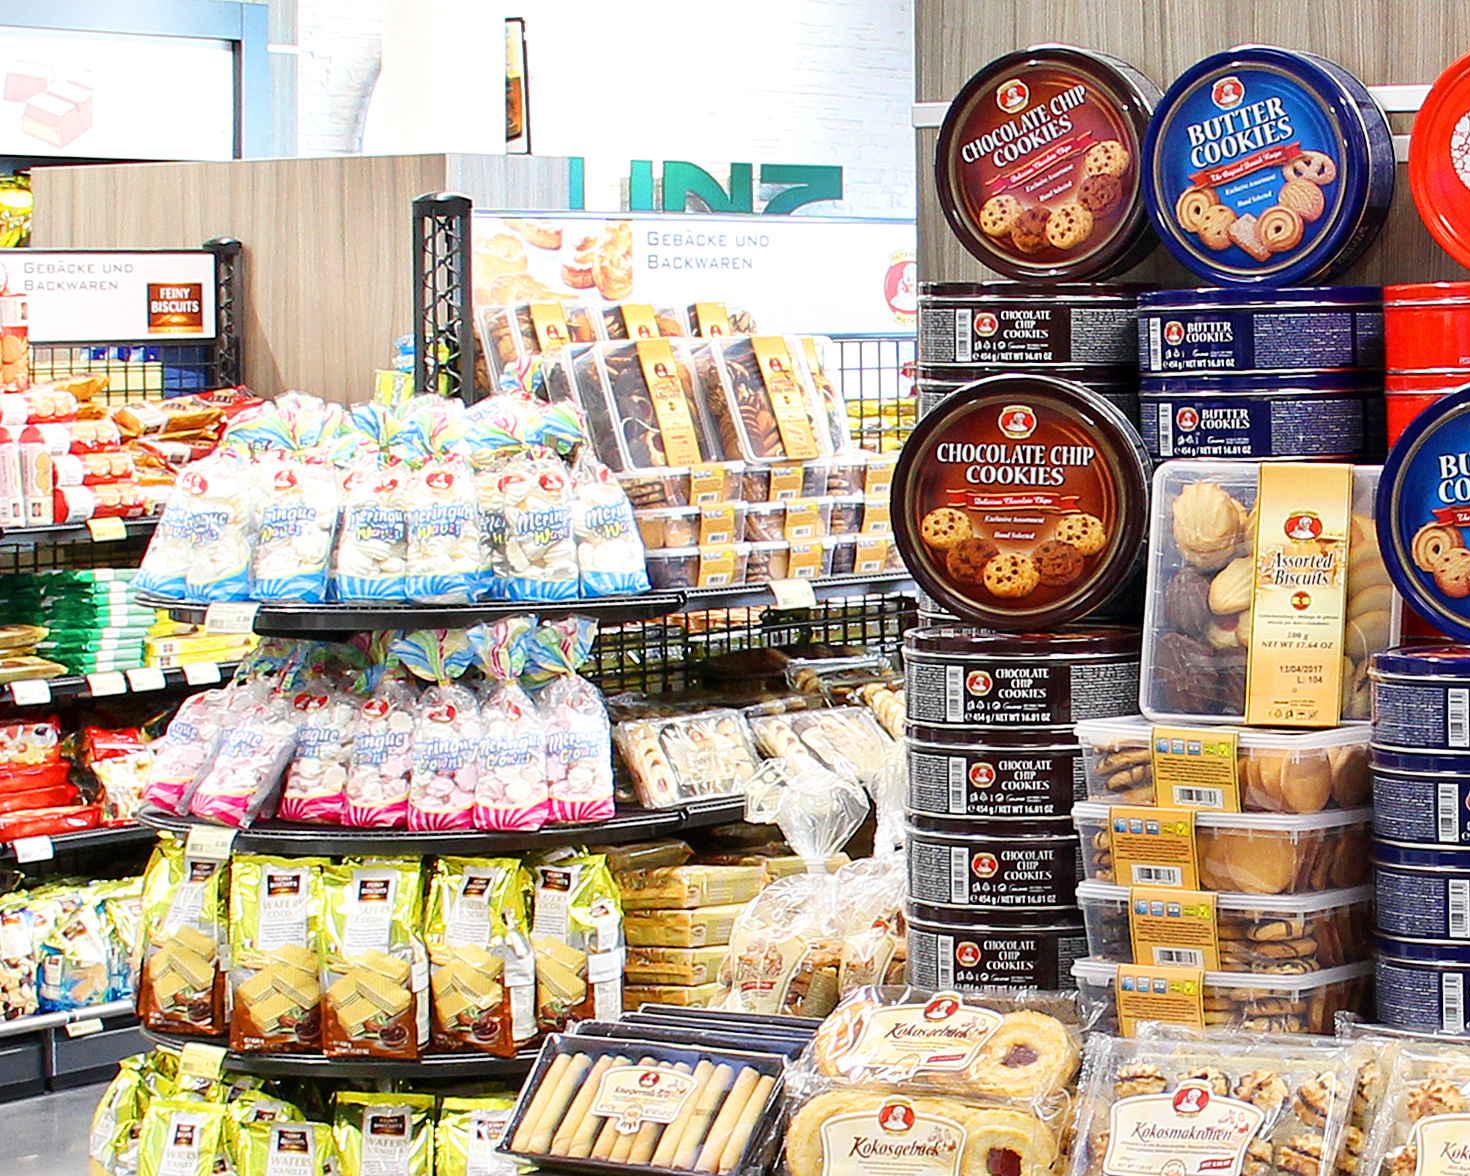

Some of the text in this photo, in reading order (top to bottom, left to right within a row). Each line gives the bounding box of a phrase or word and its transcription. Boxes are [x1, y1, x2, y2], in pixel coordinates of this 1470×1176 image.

[961, 84, 1088, 164] CHOCOLATE CHIP
[1187, 97, 1287, 147] BUTTER
[992, 114, 1074, 168] COOKIES
[1189, 115, 1294, 169] COOKIES
[160, 287, 191, 299] FEINY
[151, 300, 200, 314] BISCUITS
[1000, 310, 1051, 321] CHOCOLATE
[1015, 320, 1037, 330] CHIP
[1186, 322, 1233, 333] BUTTER
[1002, 329, 1050, 340] COOKIES
[1185, 332, 1235, 343] COOKIES
[1201, 408, 1250, 419] BUTTER
[1200, 418, 1251, 430] COOKIES
[937, 443, 1095, 467] CHOCOLATE CHIP
[966, 465, 1065, 486] COOKIES
[1272, 551, 1334, 570] Assorted
[1274, 569, 1330, 587] Biscuits
[995, 668, 1050, 679] CHOCOLATE
[1010, 678, 1033, 689] CHIP
[998, 688, 1047, 699] COOKIES
[998, 760, 1052, 771] CHOCOLATE
[1014, 770, 1036, 780] CHIP
[1001, 780, 1050, 791] COOKIES
[1001, 851, 1055, 861] CHOCOLATE
[1016, 860, 1039, 871] CHIP
[1003, 871, 1052, 881] COOKIES
[984, 940, 1036, 951] CHOCOLATE
[998, 950, 1020, 961] CHIP
[986, 960, 1034, 971] COOKIES
[1131, 1122, 1233, 1143] Kokosmakronen
